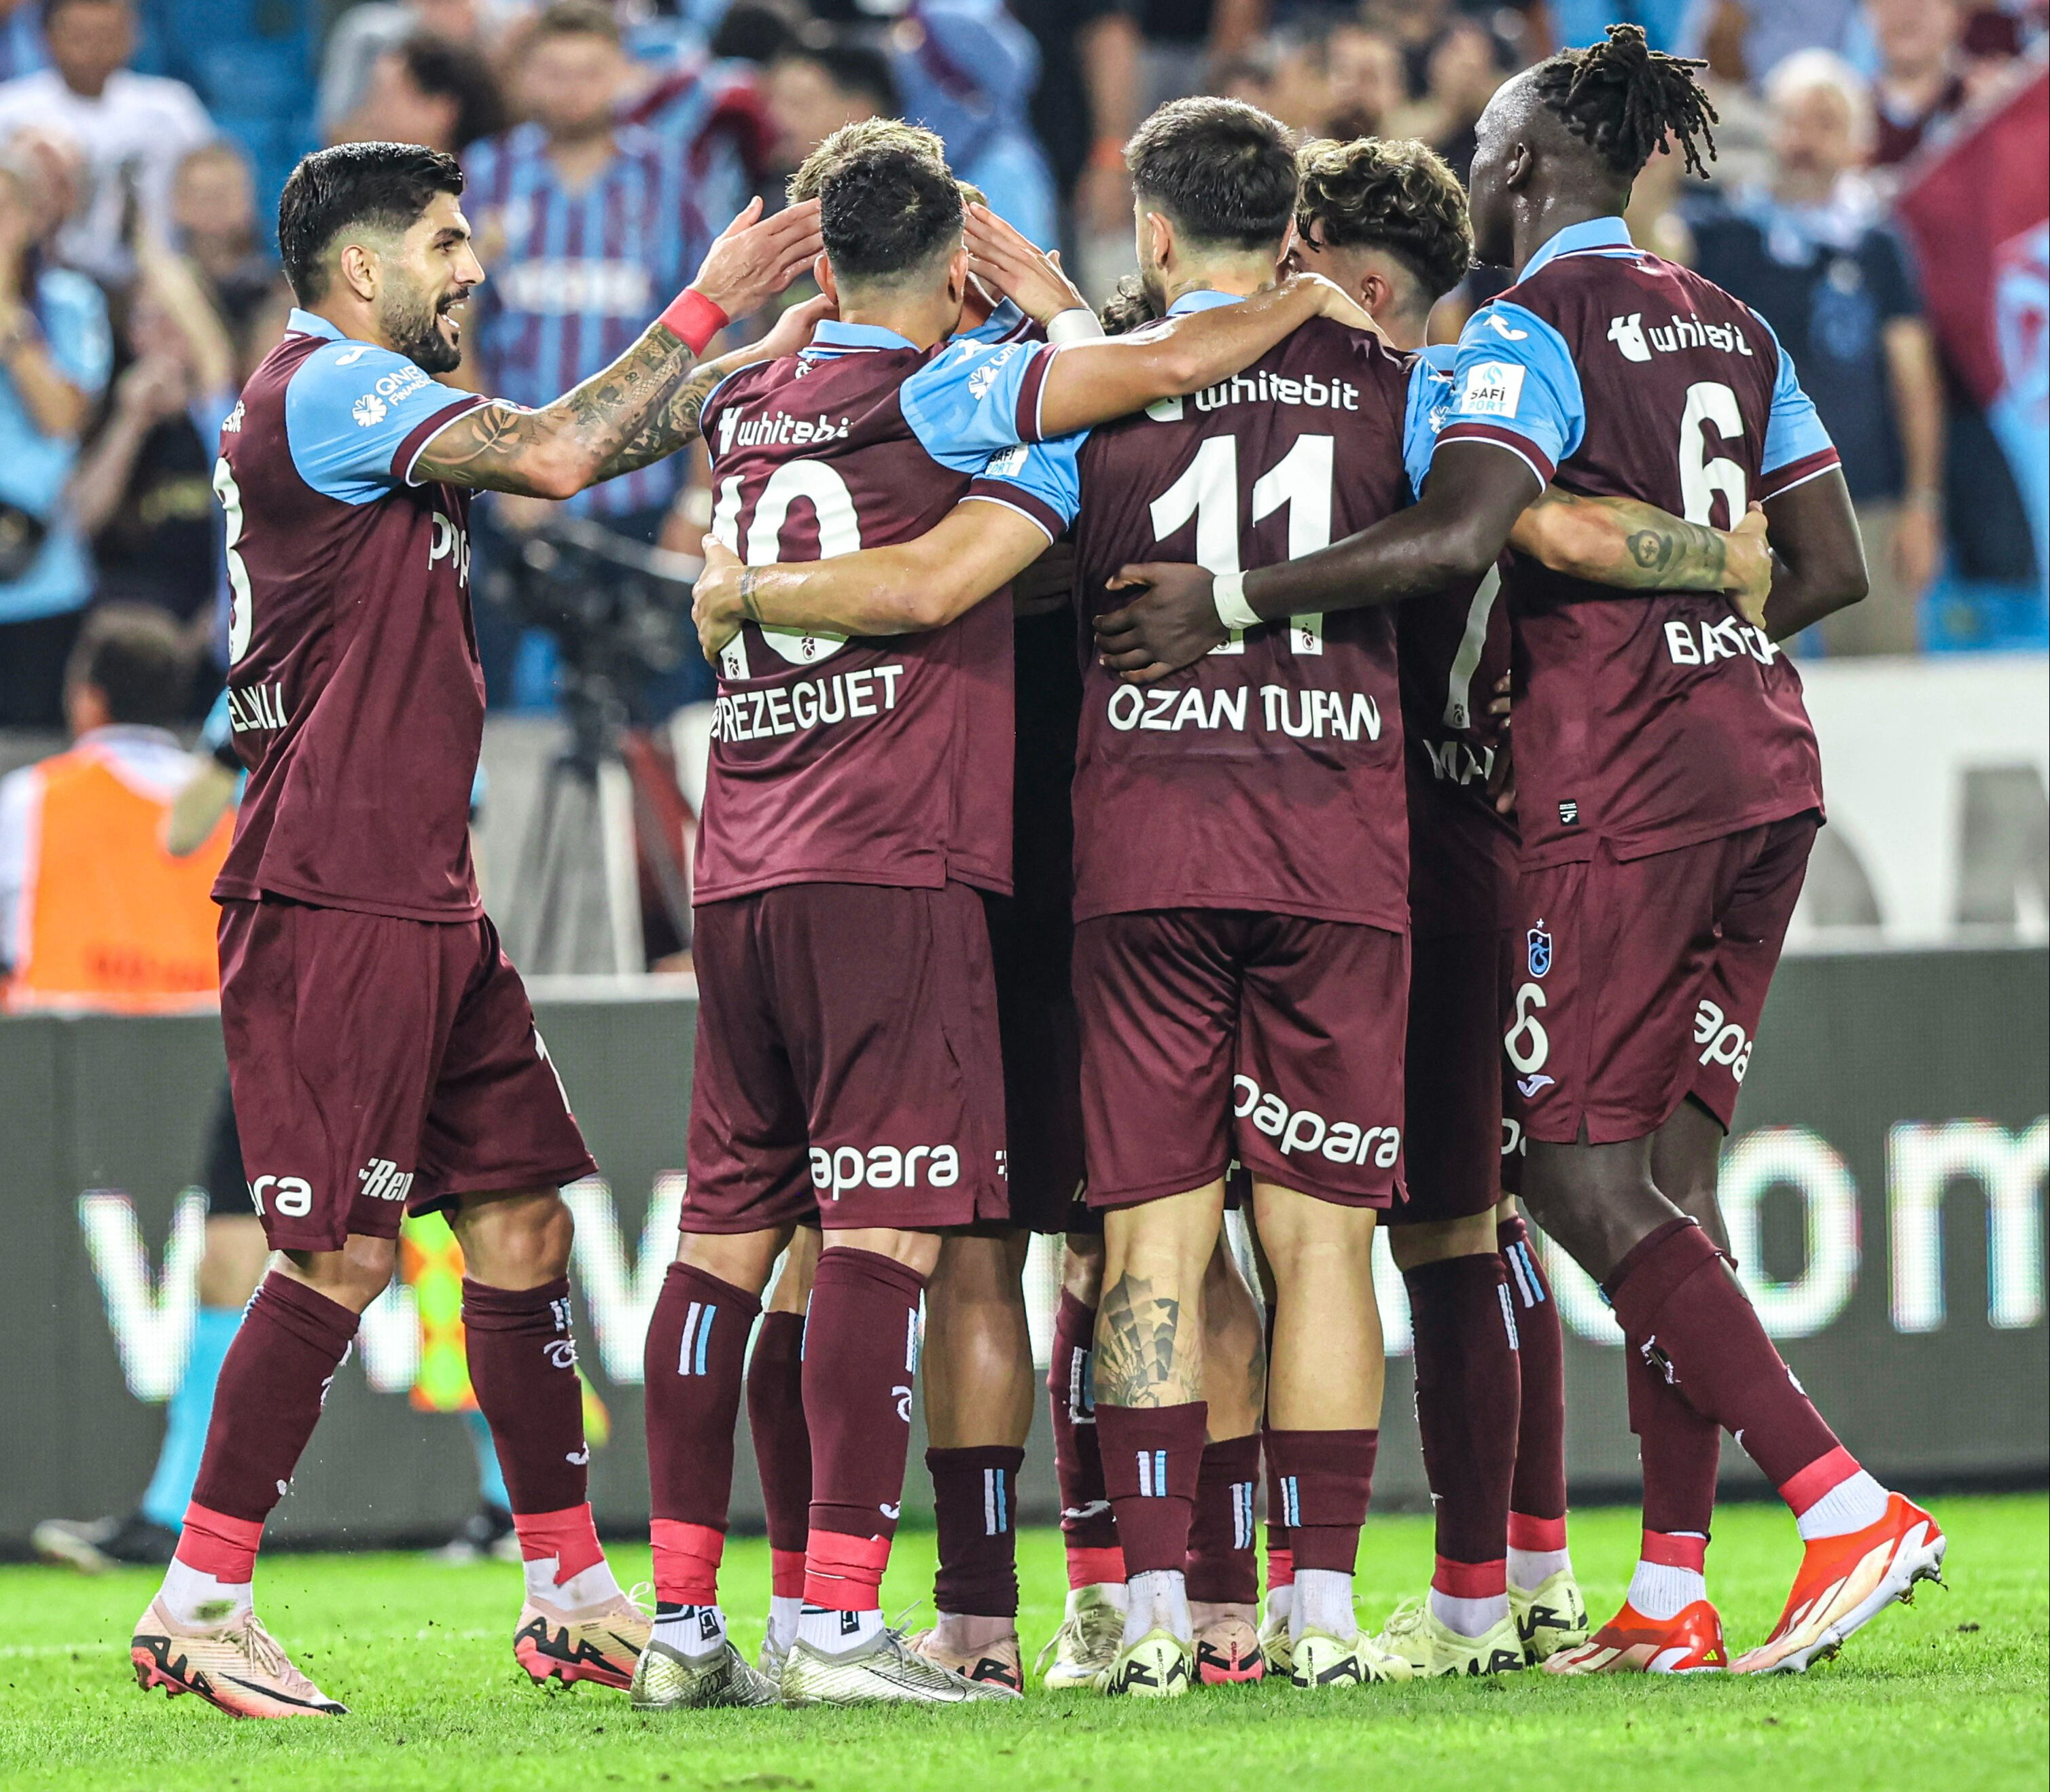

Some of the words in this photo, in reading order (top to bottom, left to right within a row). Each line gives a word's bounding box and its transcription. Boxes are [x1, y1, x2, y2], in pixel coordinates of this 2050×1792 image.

[375, 365, 423, 395] QNB
[737, 410, 854, 446] whitebi
[1679, 382, 1746, 532] 6
[711, 460, 860, 679] 10
[1150, 434, 1334, 654] 11
[1108, 685, 1247, 731] OZAN
[1260, 685, 1380, 740] TUFAN
[1504, 982, 1549, 1073] 6
[1156, 1647, 1166, 1684] MERCURIAL
